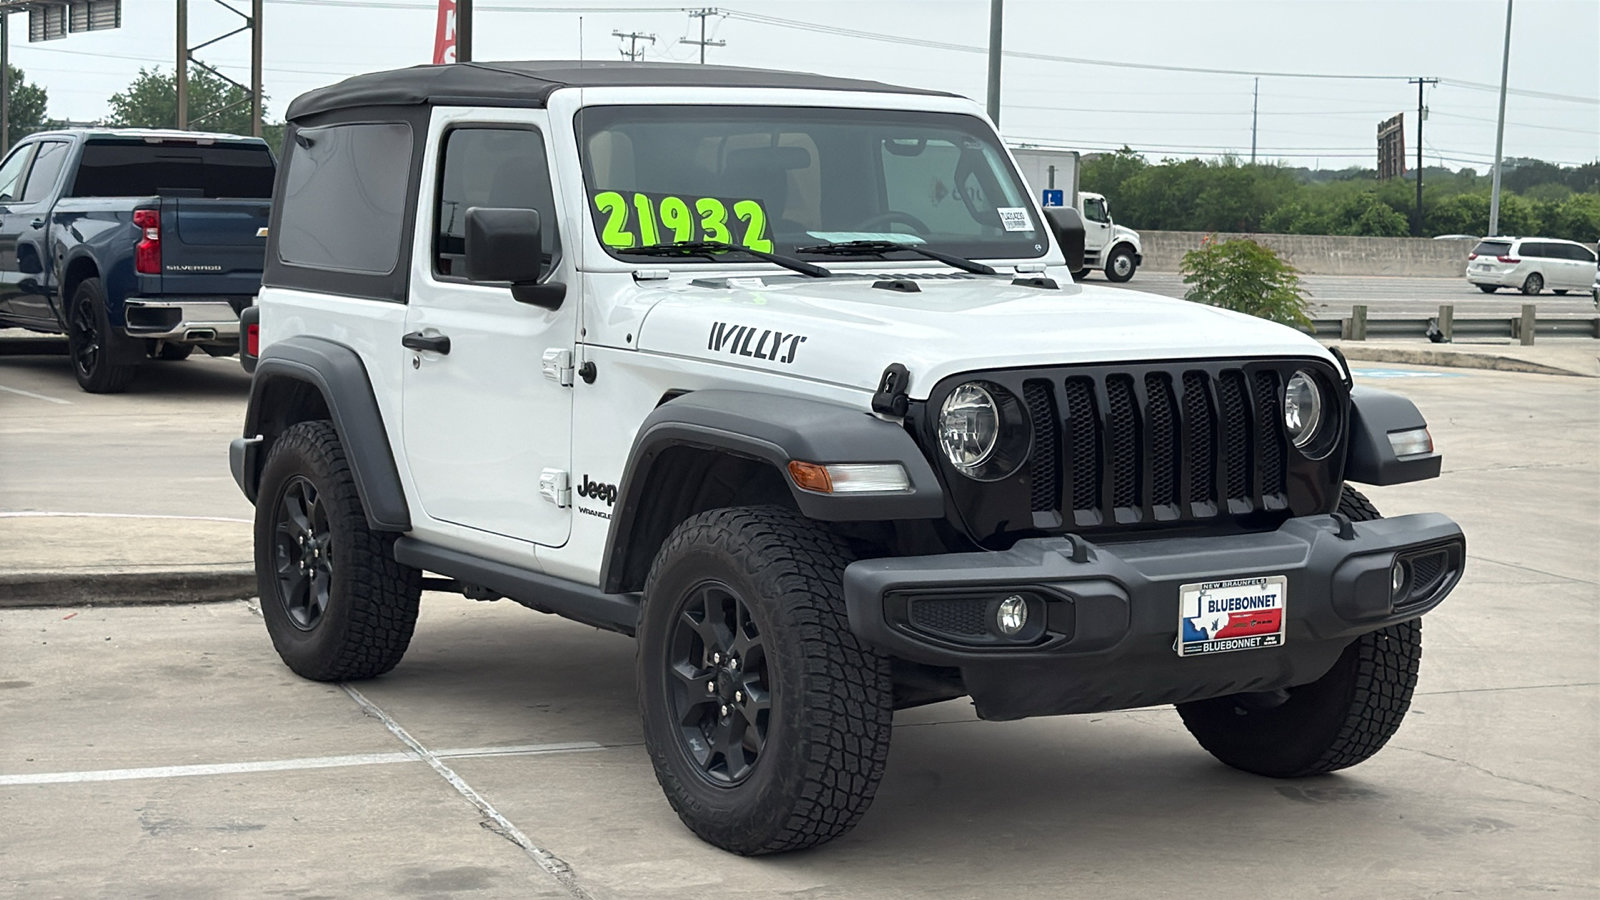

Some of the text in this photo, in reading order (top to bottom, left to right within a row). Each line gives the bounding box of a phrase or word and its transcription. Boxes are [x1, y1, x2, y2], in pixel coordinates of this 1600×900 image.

[594, 191, 774, 256] 21932
[708, 321, 808, 364] WILLYS
[577, 474, 618, 506] Jeep
[578, 506, 613, 520] WRANGLE
[1222, 579, 1265, 588] BRAUNFELS
[1208, 594, 1277, 613] BLUEBONNET
[1203, 637, 1262, 652] BLUEBONNET
